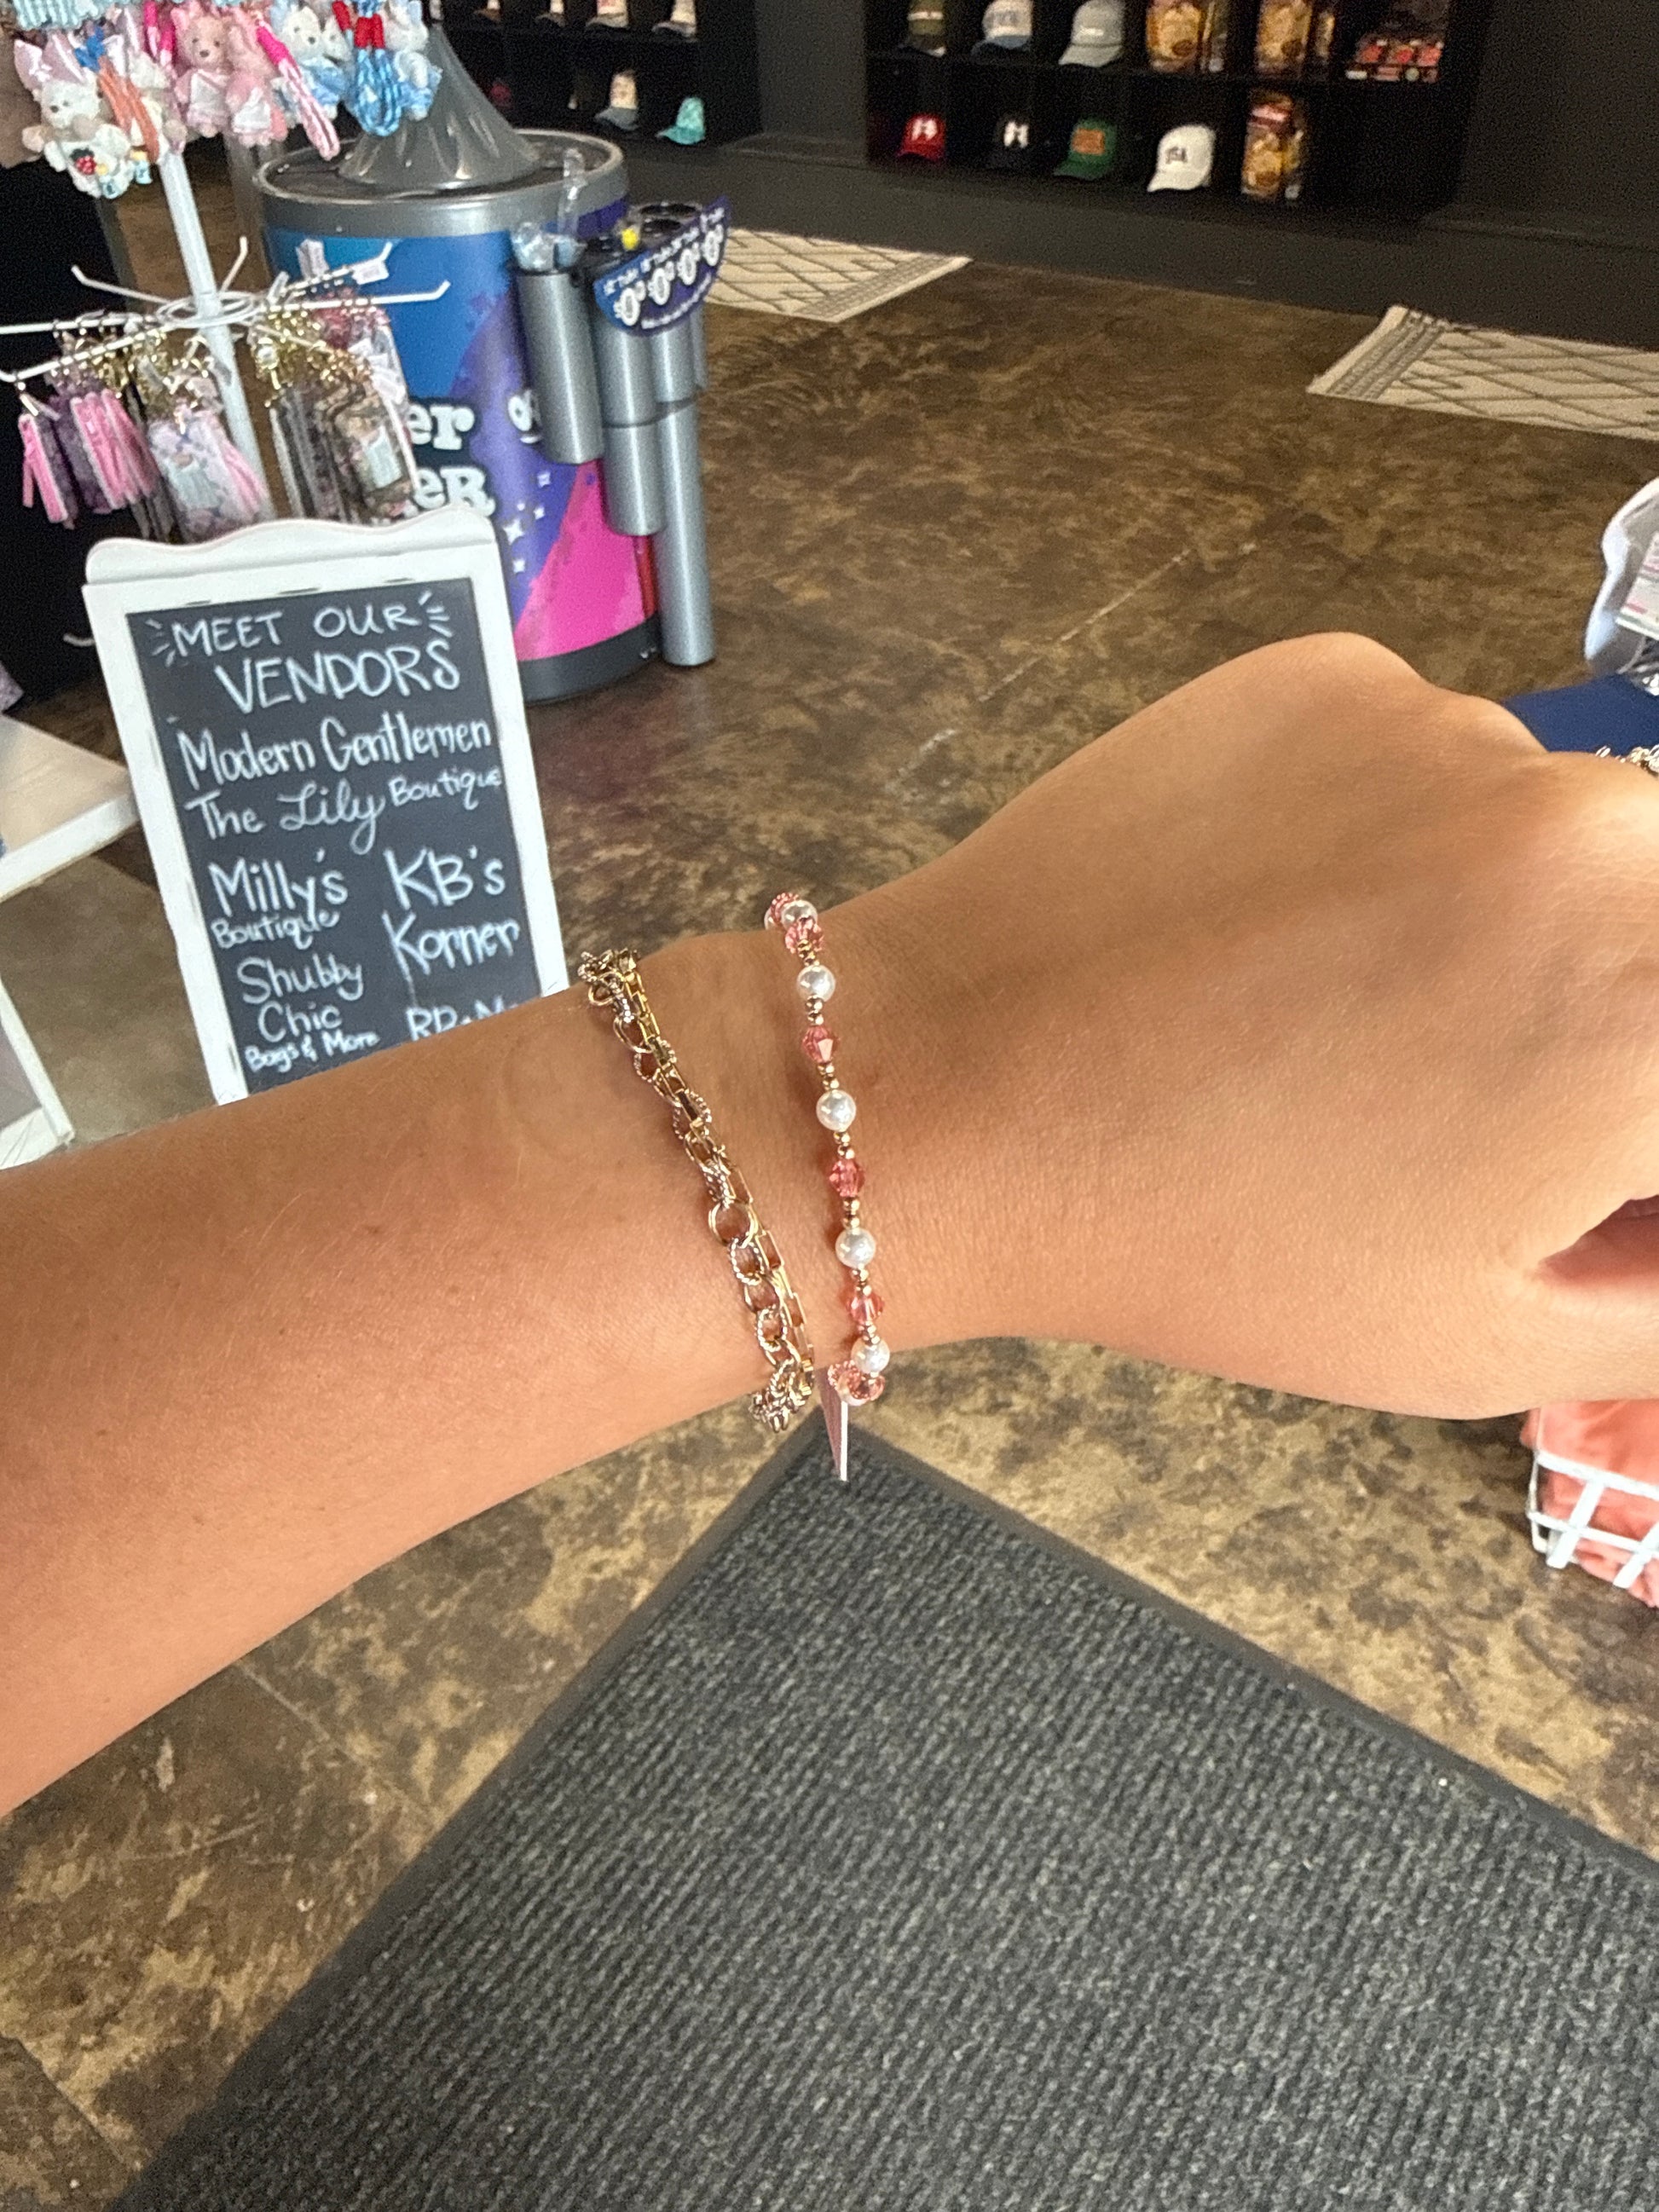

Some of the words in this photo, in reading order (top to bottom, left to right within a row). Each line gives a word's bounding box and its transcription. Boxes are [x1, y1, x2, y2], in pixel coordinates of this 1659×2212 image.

[172, 610, 284, 658] MEET
[313, 603, 422, 639] OUR
[215, 638, 460, 713] VENDORS
[175, 726, 316, 789] Modern
[319, 710, 492, 772] Gentlemen
[183, 788, 268, 840] The
[276, 779, 386, 855] Lily
[388, 765, 503, 811] Boutique
[208, 847, 349, 917] Milly's
[383, 845, 506, 910] KB's
[210, 909, 341, 950] Boutique
[382, 910, 521, 982] Korner
[258, 1001, 343, 1042] Chic
[321, 1028, 381, 1057] More
